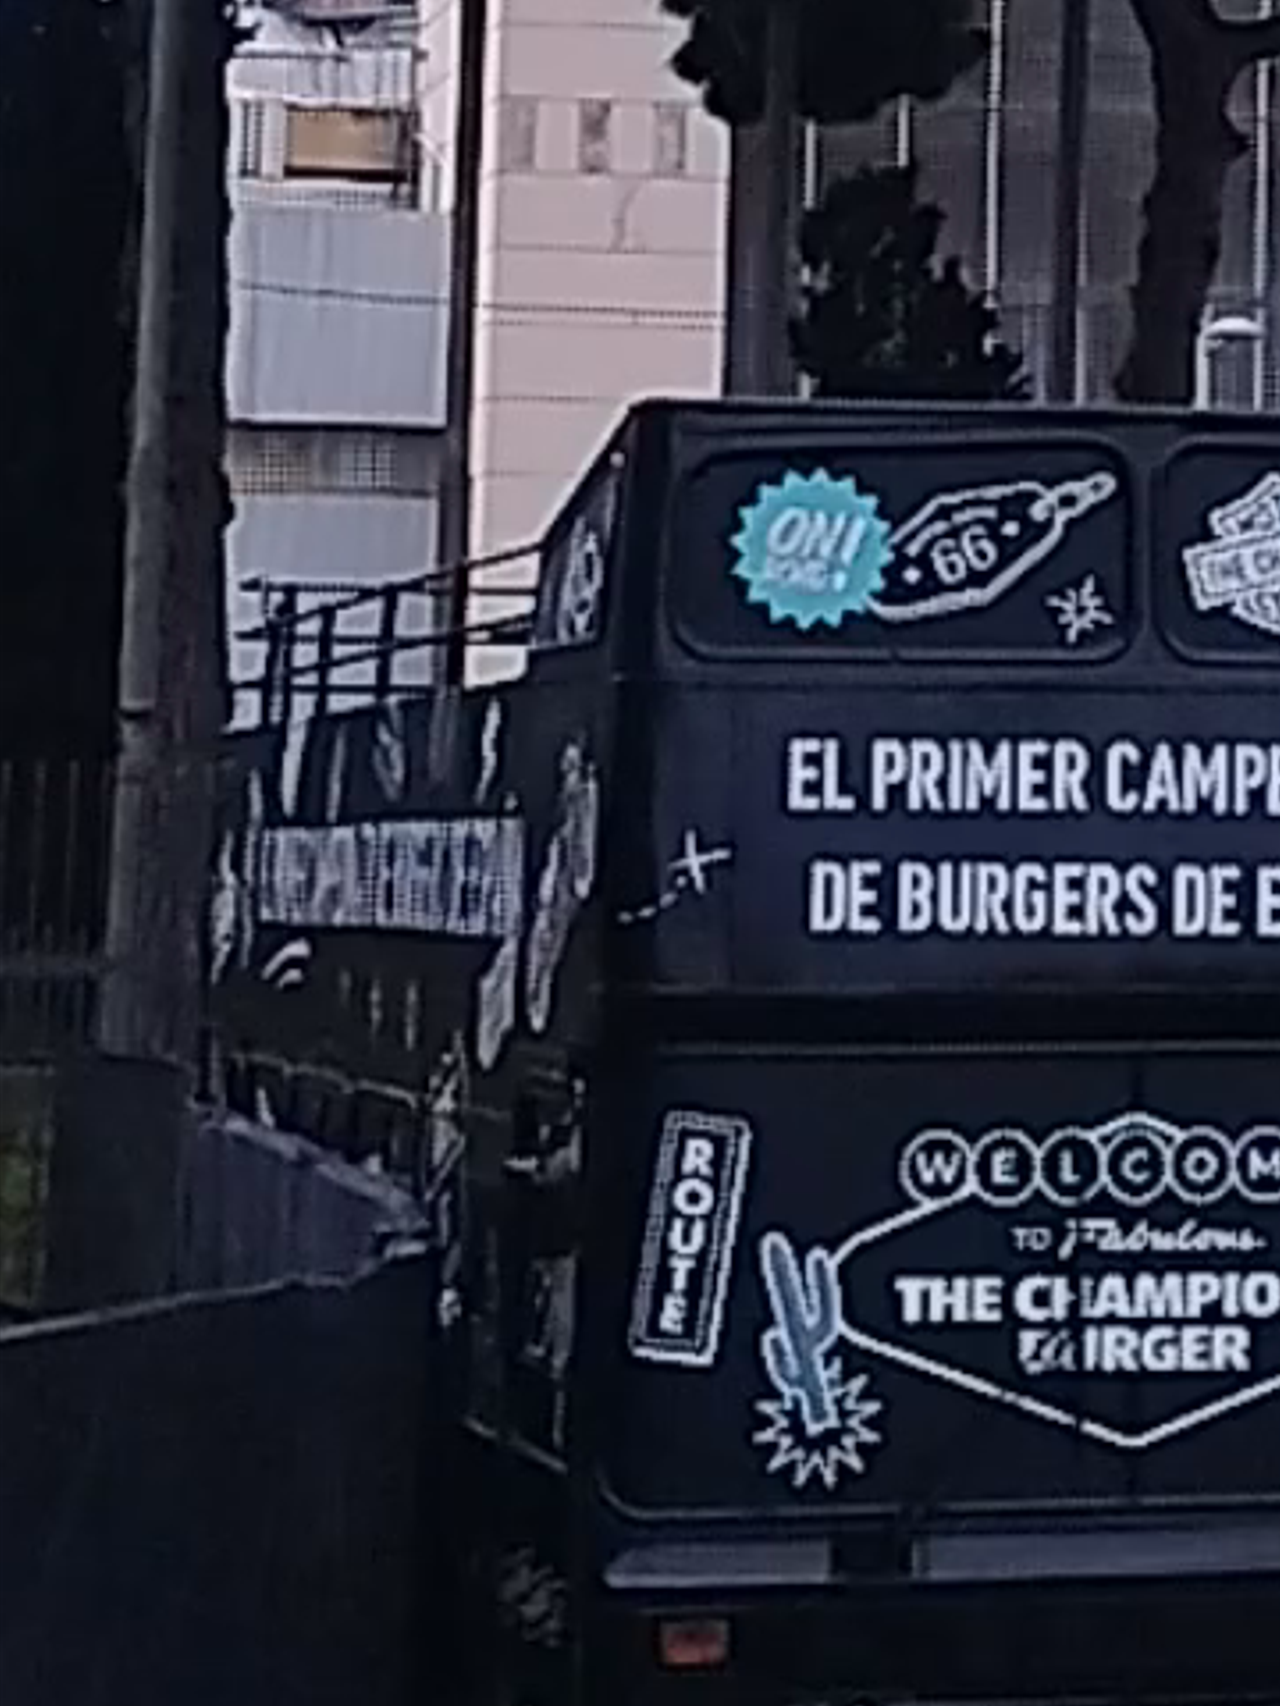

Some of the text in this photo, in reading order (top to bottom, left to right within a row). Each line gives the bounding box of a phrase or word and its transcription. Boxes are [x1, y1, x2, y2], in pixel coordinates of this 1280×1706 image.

[931, 525, 998, 584] 66
[788, 738, 856, 811] EL
[871, 738, 1090, 812] PRIMER
[809, 860, 882, 934] DE
[898, 861, 1158, 936] BURGERS
[1172, 863, 1242, 936] DE
[659, 1138, 715, 1336] ROUTE
[895, 1276, 1004, 1324] THE
